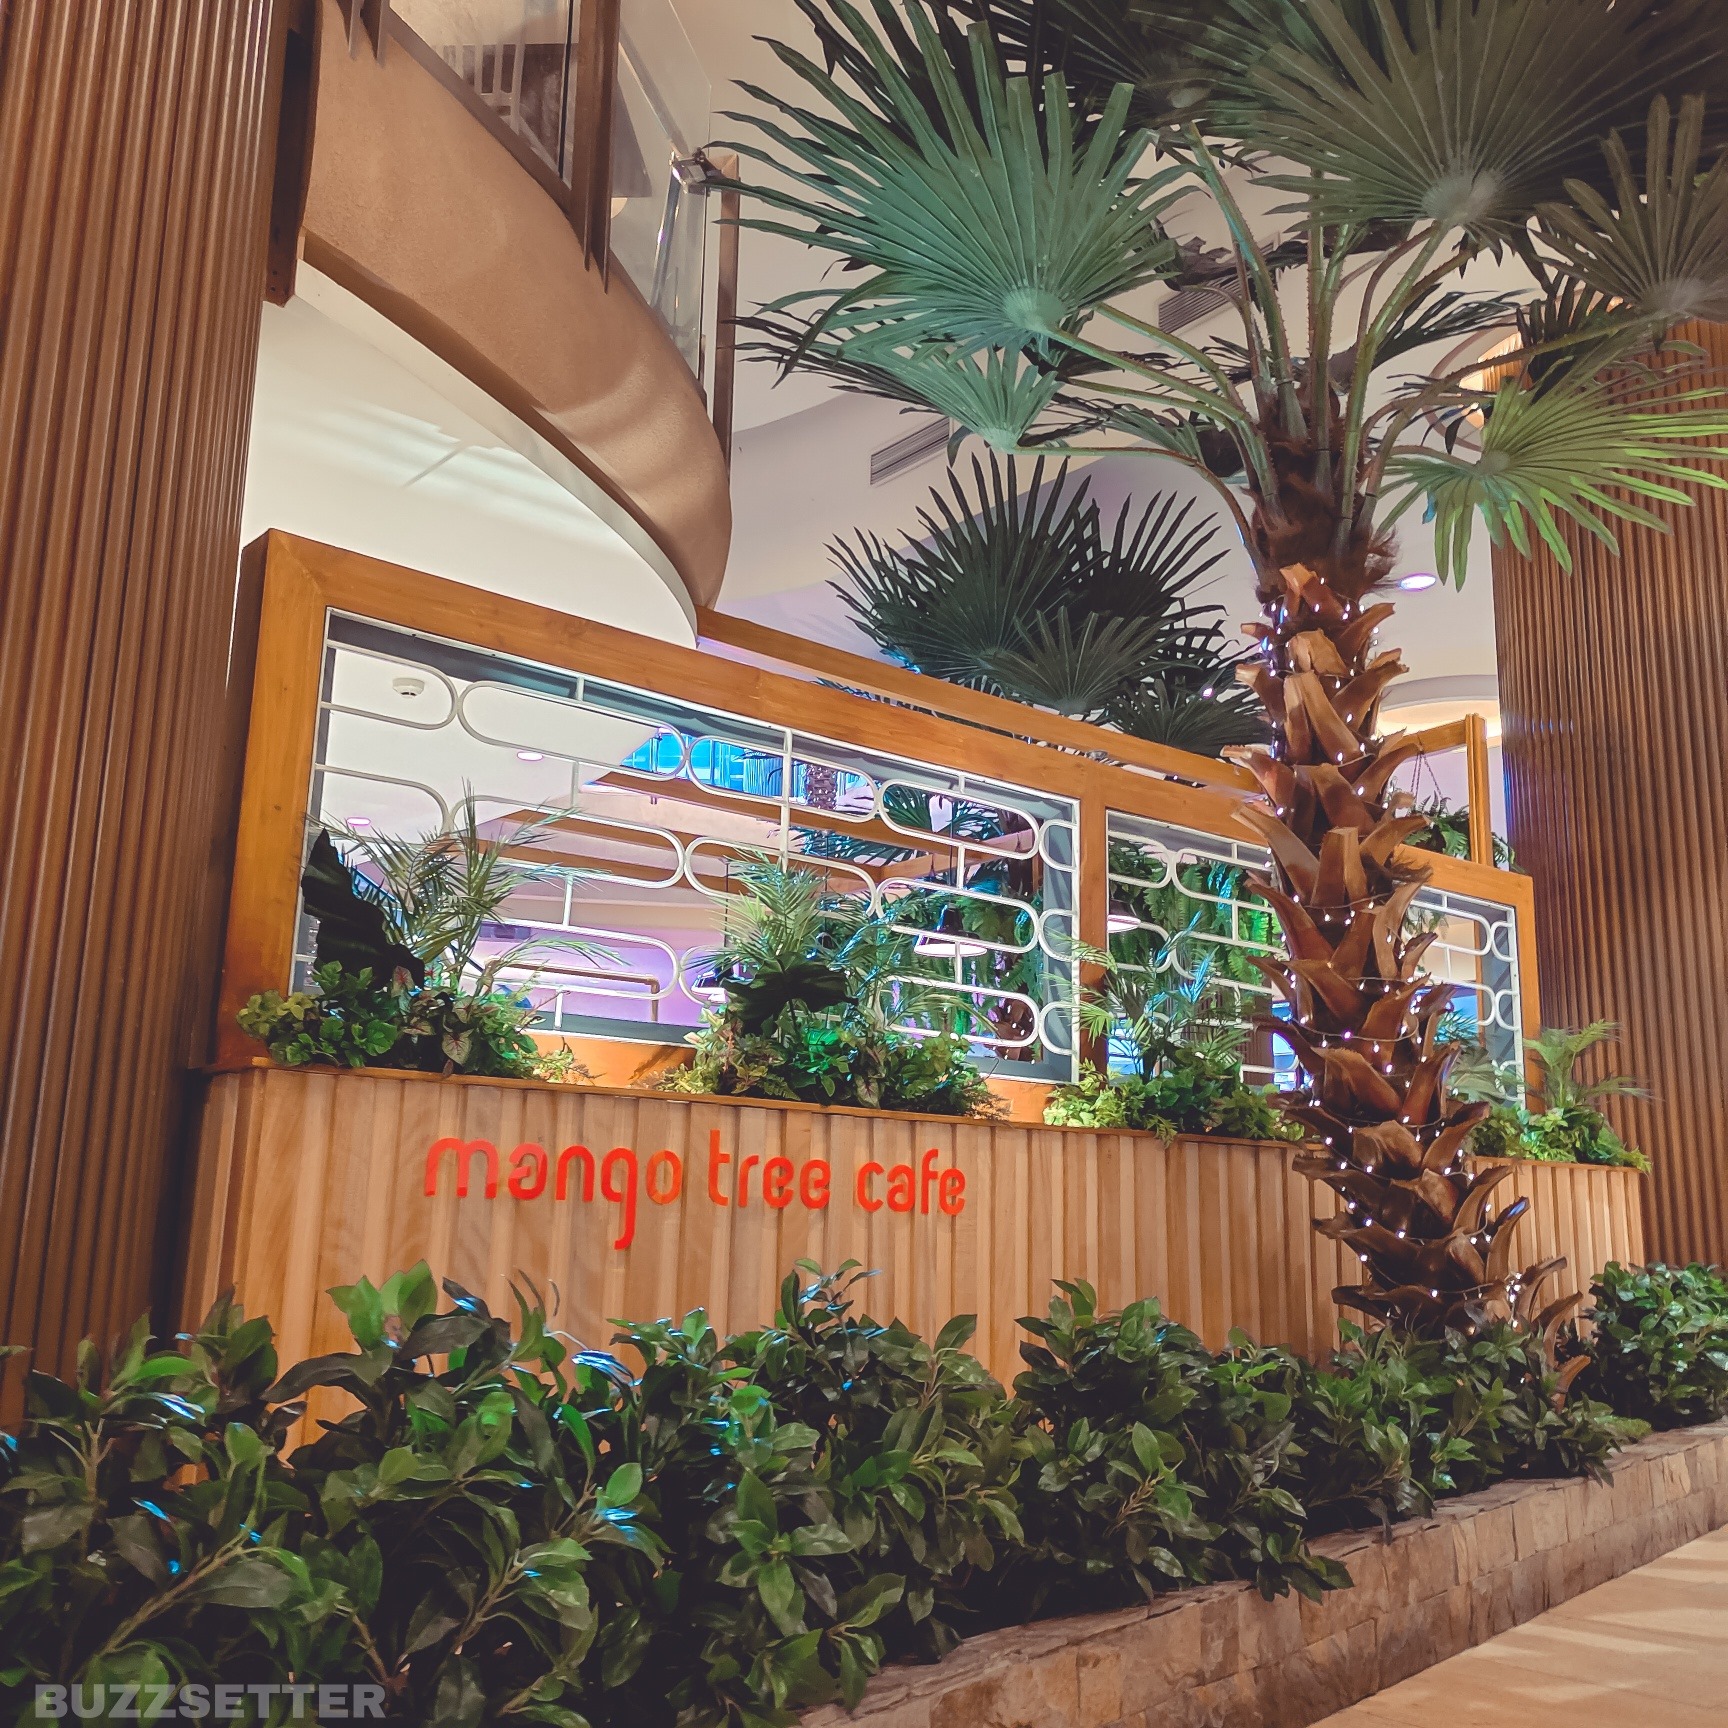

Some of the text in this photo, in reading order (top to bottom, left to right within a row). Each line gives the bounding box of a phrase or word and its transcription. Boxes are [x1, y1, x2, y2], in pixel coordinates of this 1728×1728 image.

[424, 1129, 966, 1250] mango tree cafe
